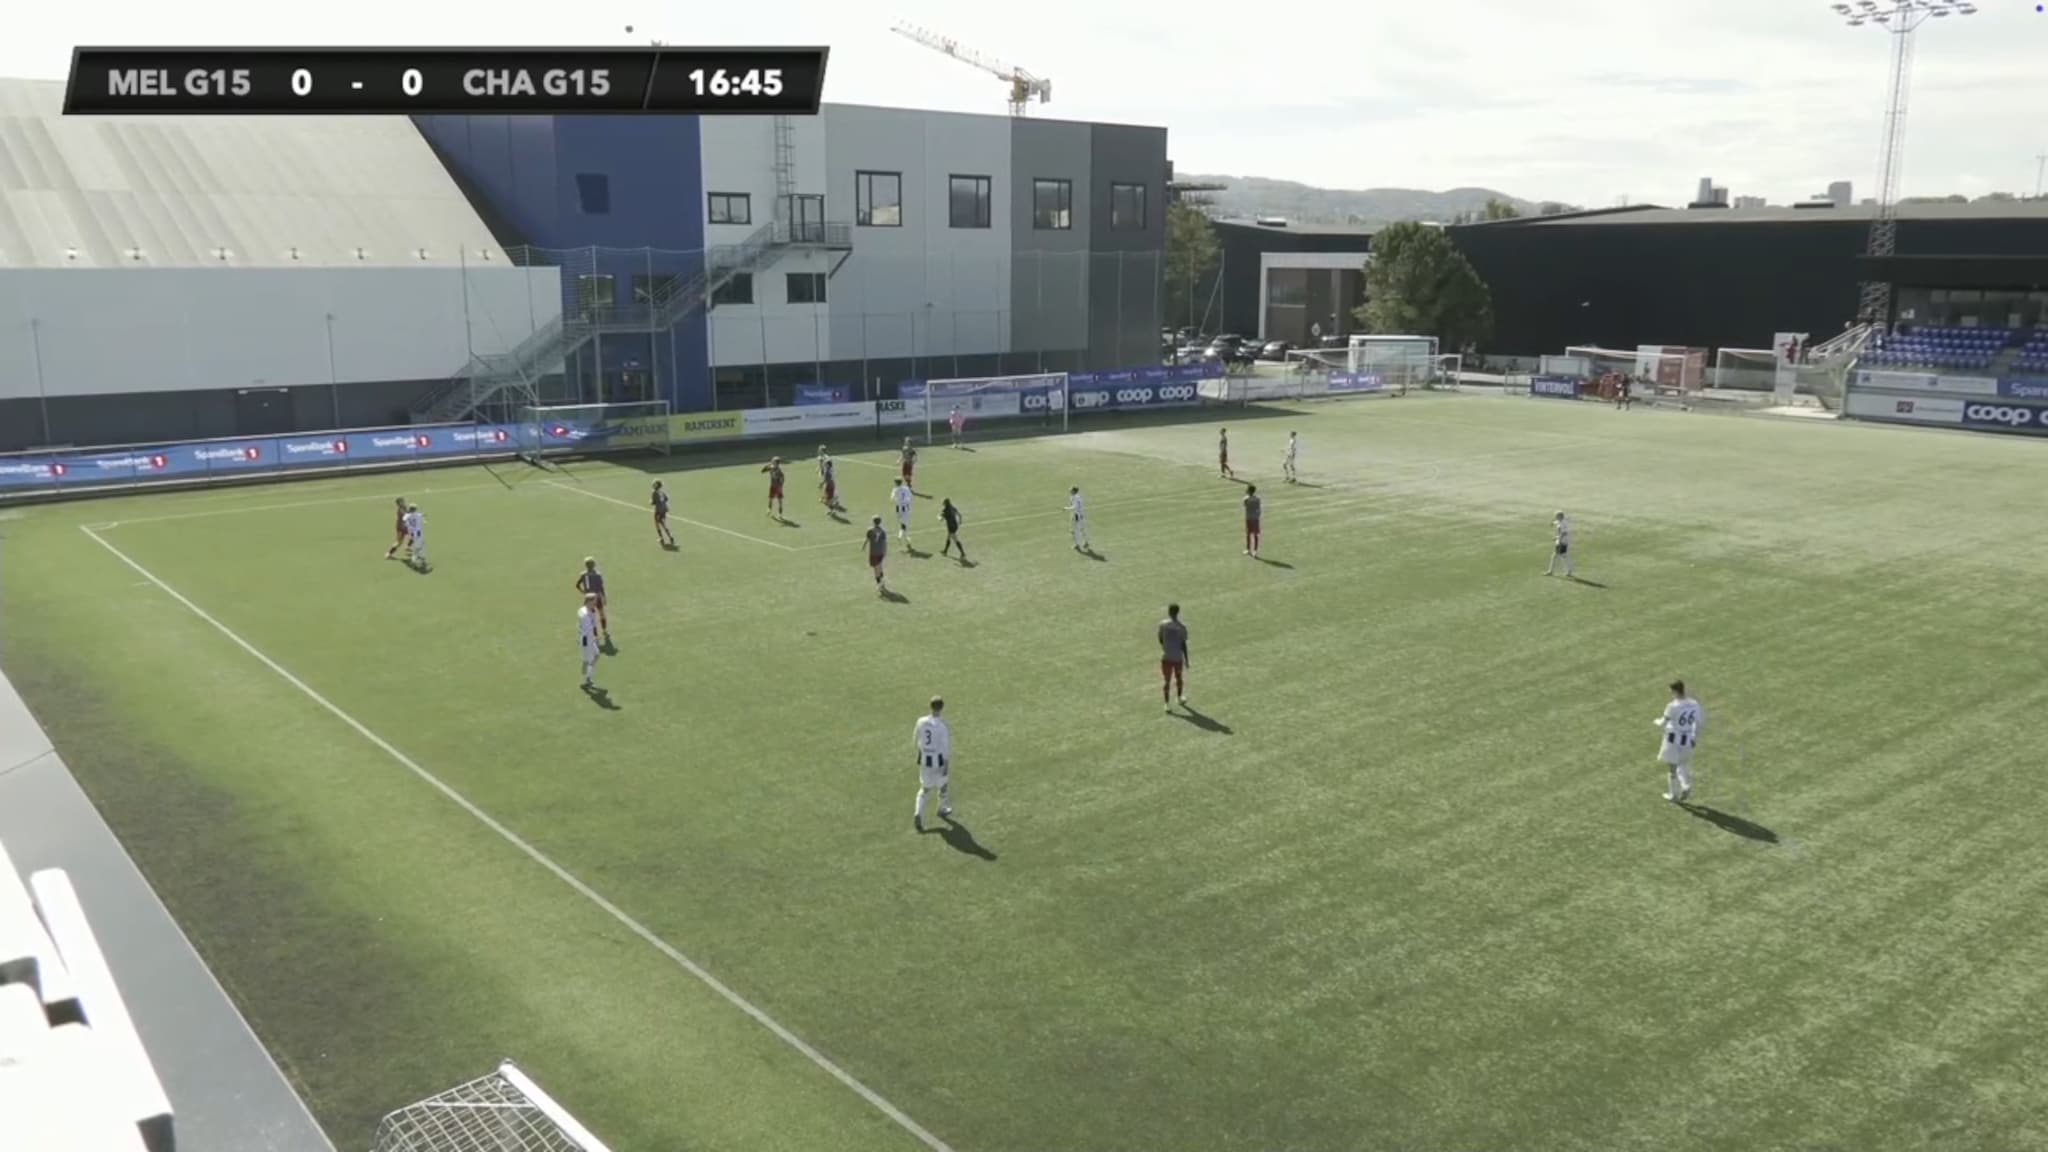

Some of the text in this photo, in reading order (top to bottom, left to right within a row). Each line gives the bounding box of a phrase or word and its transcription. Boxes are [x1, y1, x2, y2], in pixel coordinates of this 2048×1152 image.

[1117, 387, 1153, 403] coop
[1160, 385, 1194, 401] coop
[1967, 405, 2032, 426] coop
[1678, 710, 1696, 726] 66
[924, 729, 932, 746] 3
